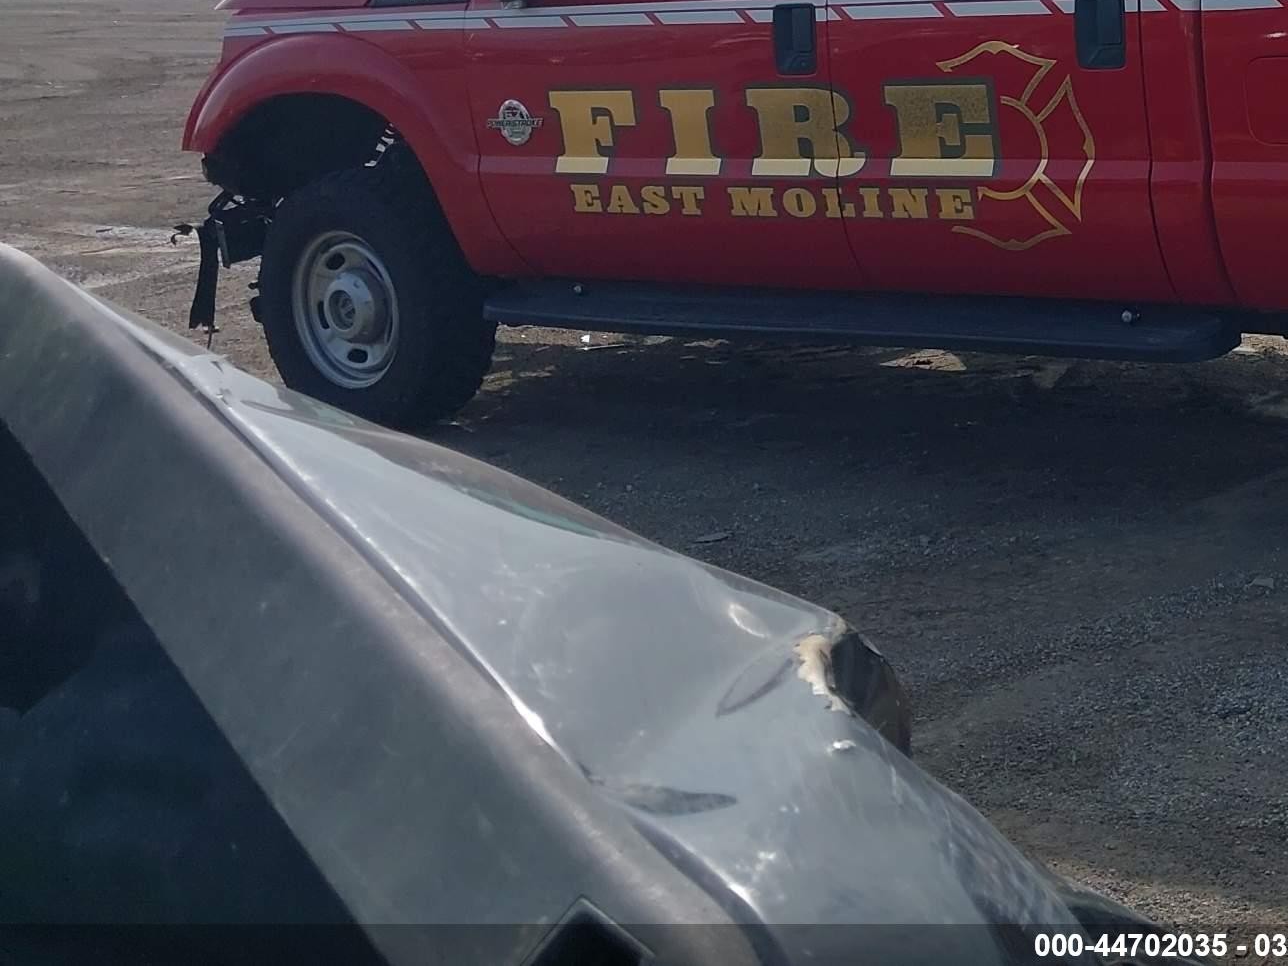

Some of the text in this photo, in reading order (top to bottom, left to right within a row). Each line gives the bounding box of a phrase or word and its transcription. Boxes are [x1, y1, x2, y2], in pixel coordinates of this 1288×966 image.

[547, 83, 995, 178] FIRE
[569, 184, 976, 221] EAST MOLINE
